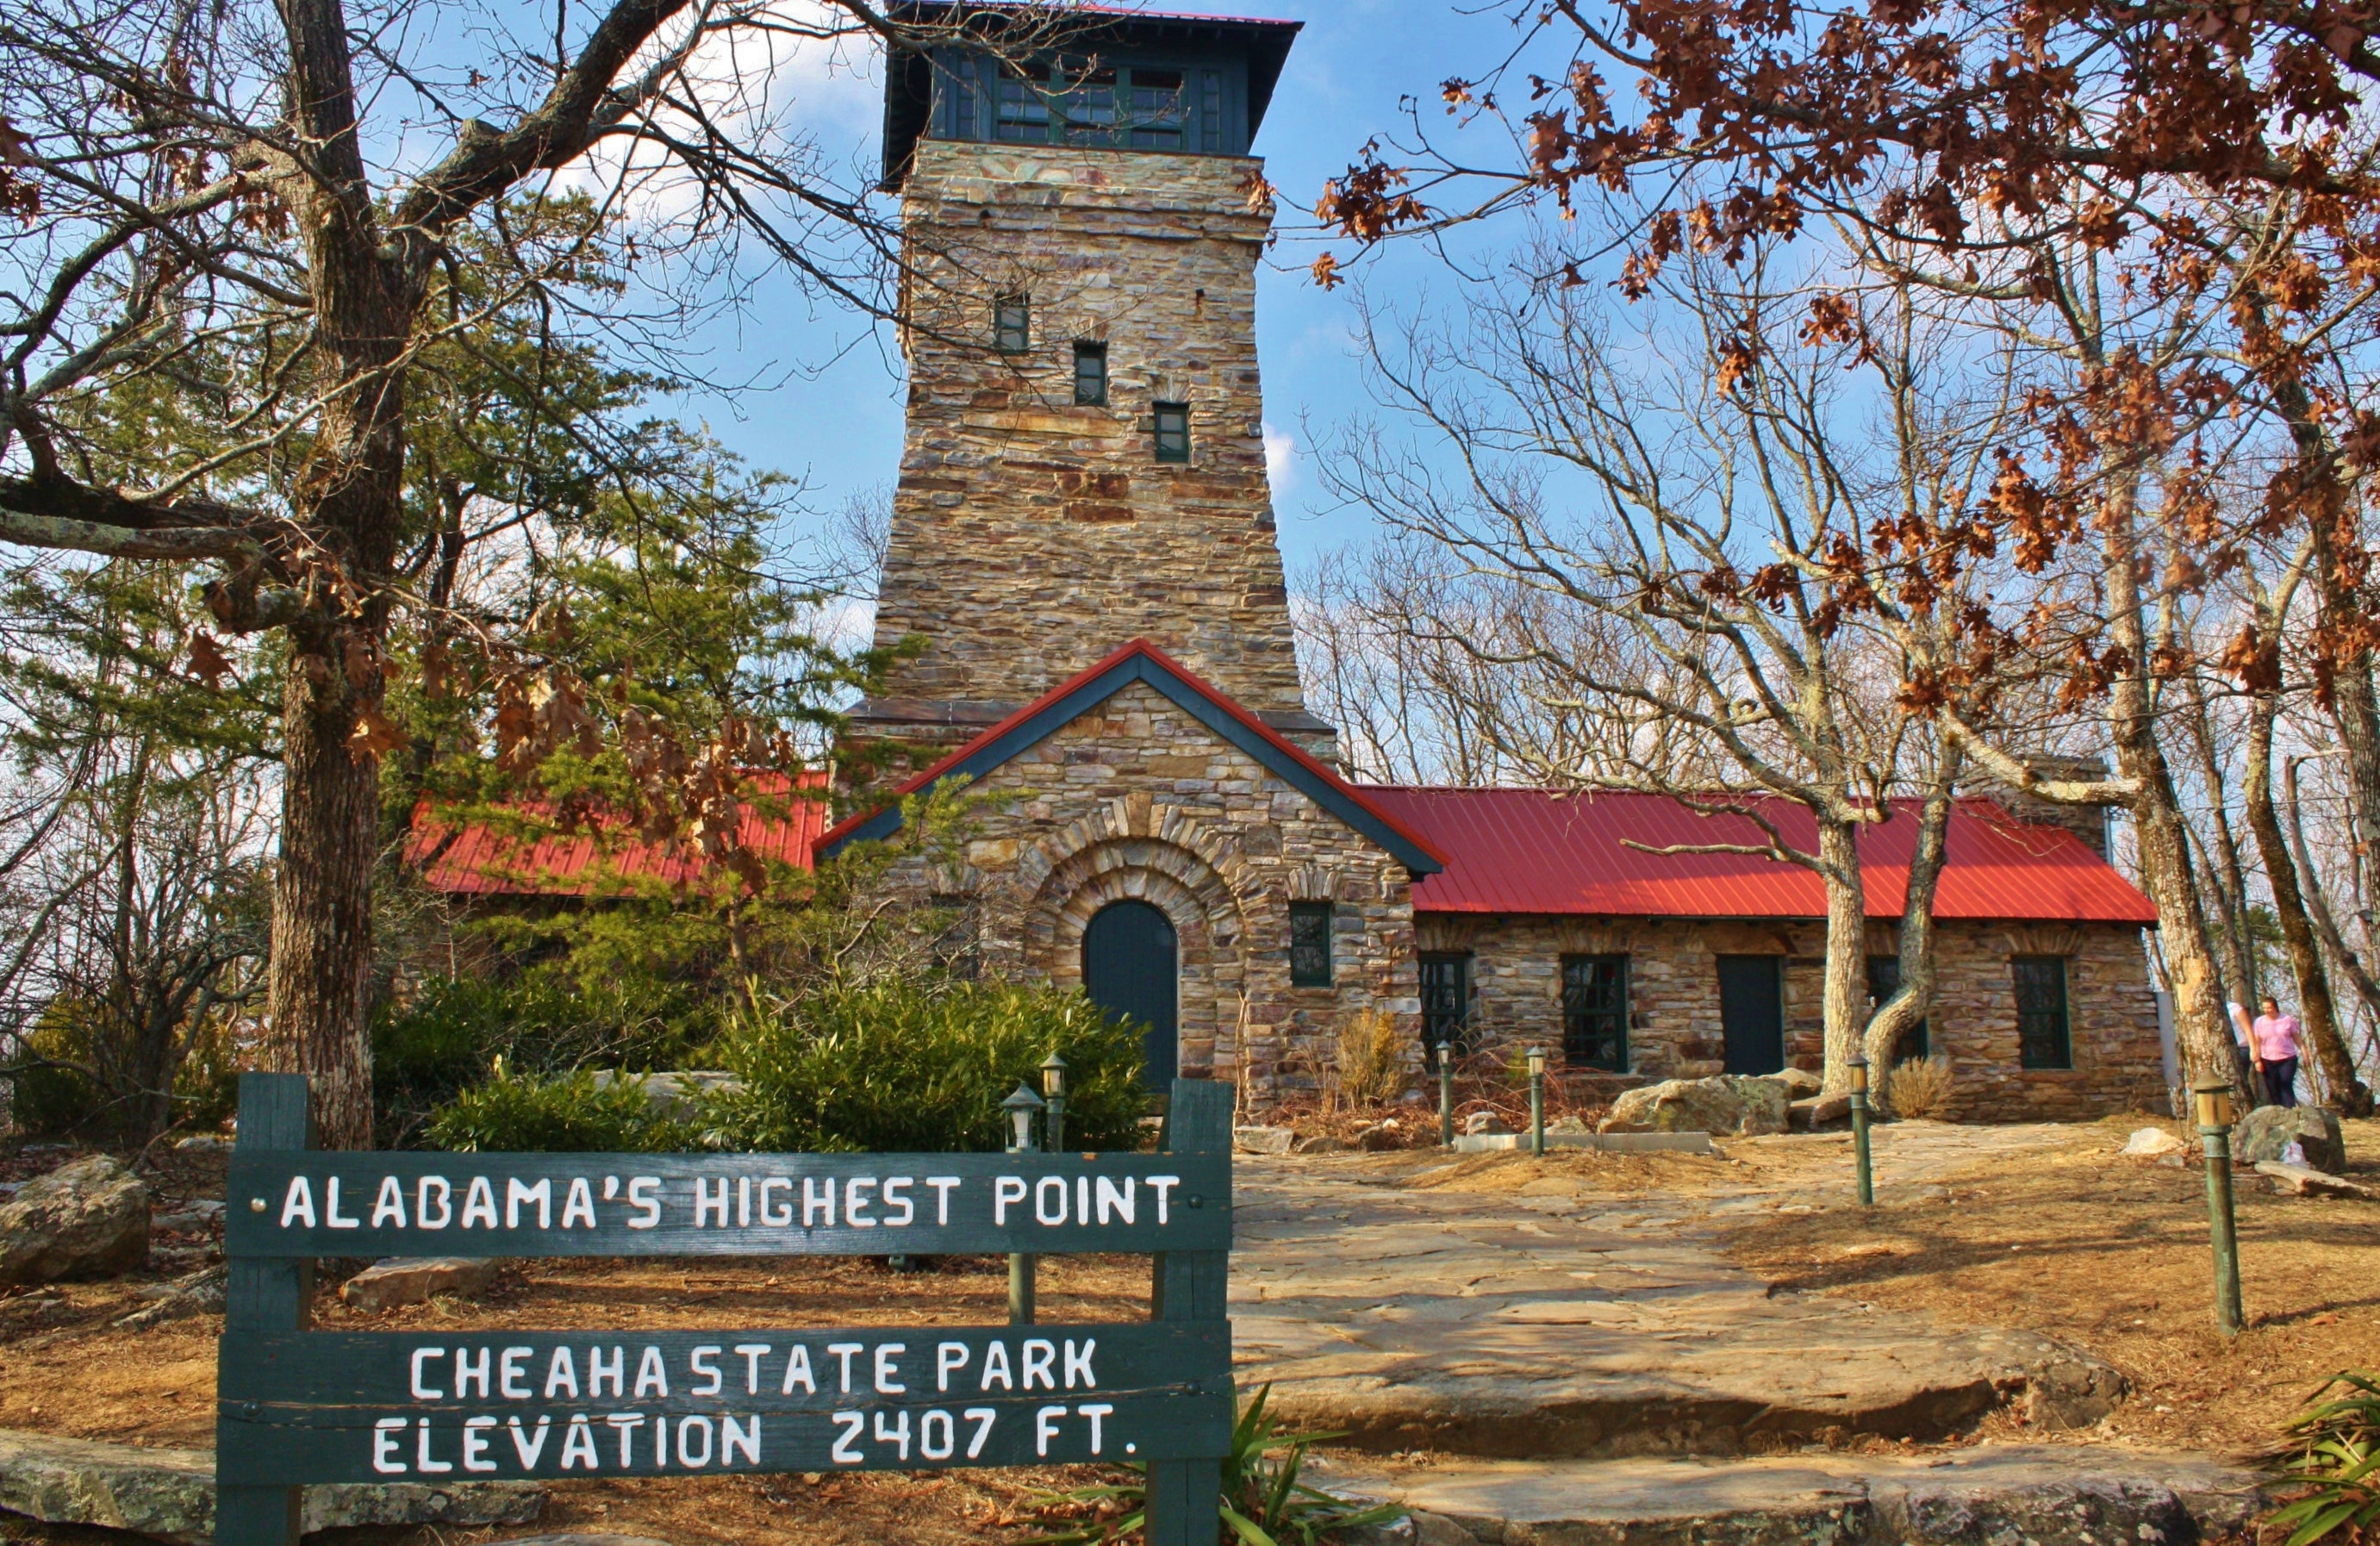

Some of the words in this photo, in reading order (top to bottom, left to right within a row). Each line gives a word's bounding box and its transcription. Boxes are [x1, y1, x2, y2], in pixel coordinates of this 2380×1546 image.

[280, 1175, 662, 1229] ALABAMA'S
[695, 1176, 961, 1228] HIGHEST
[994, 1175, 1180, 1225] POINT
[410, 1346, 669, 1399] CHEAHA
[690, 1343, 907, 1395] STATE
[937, 1338, 1096, 1392] PARK
[373, 1413, 761, 1473] ELEVATION
[832, 1407, 996, 1464] 2407
[1036, 1404, 1137, 1457] FT.
